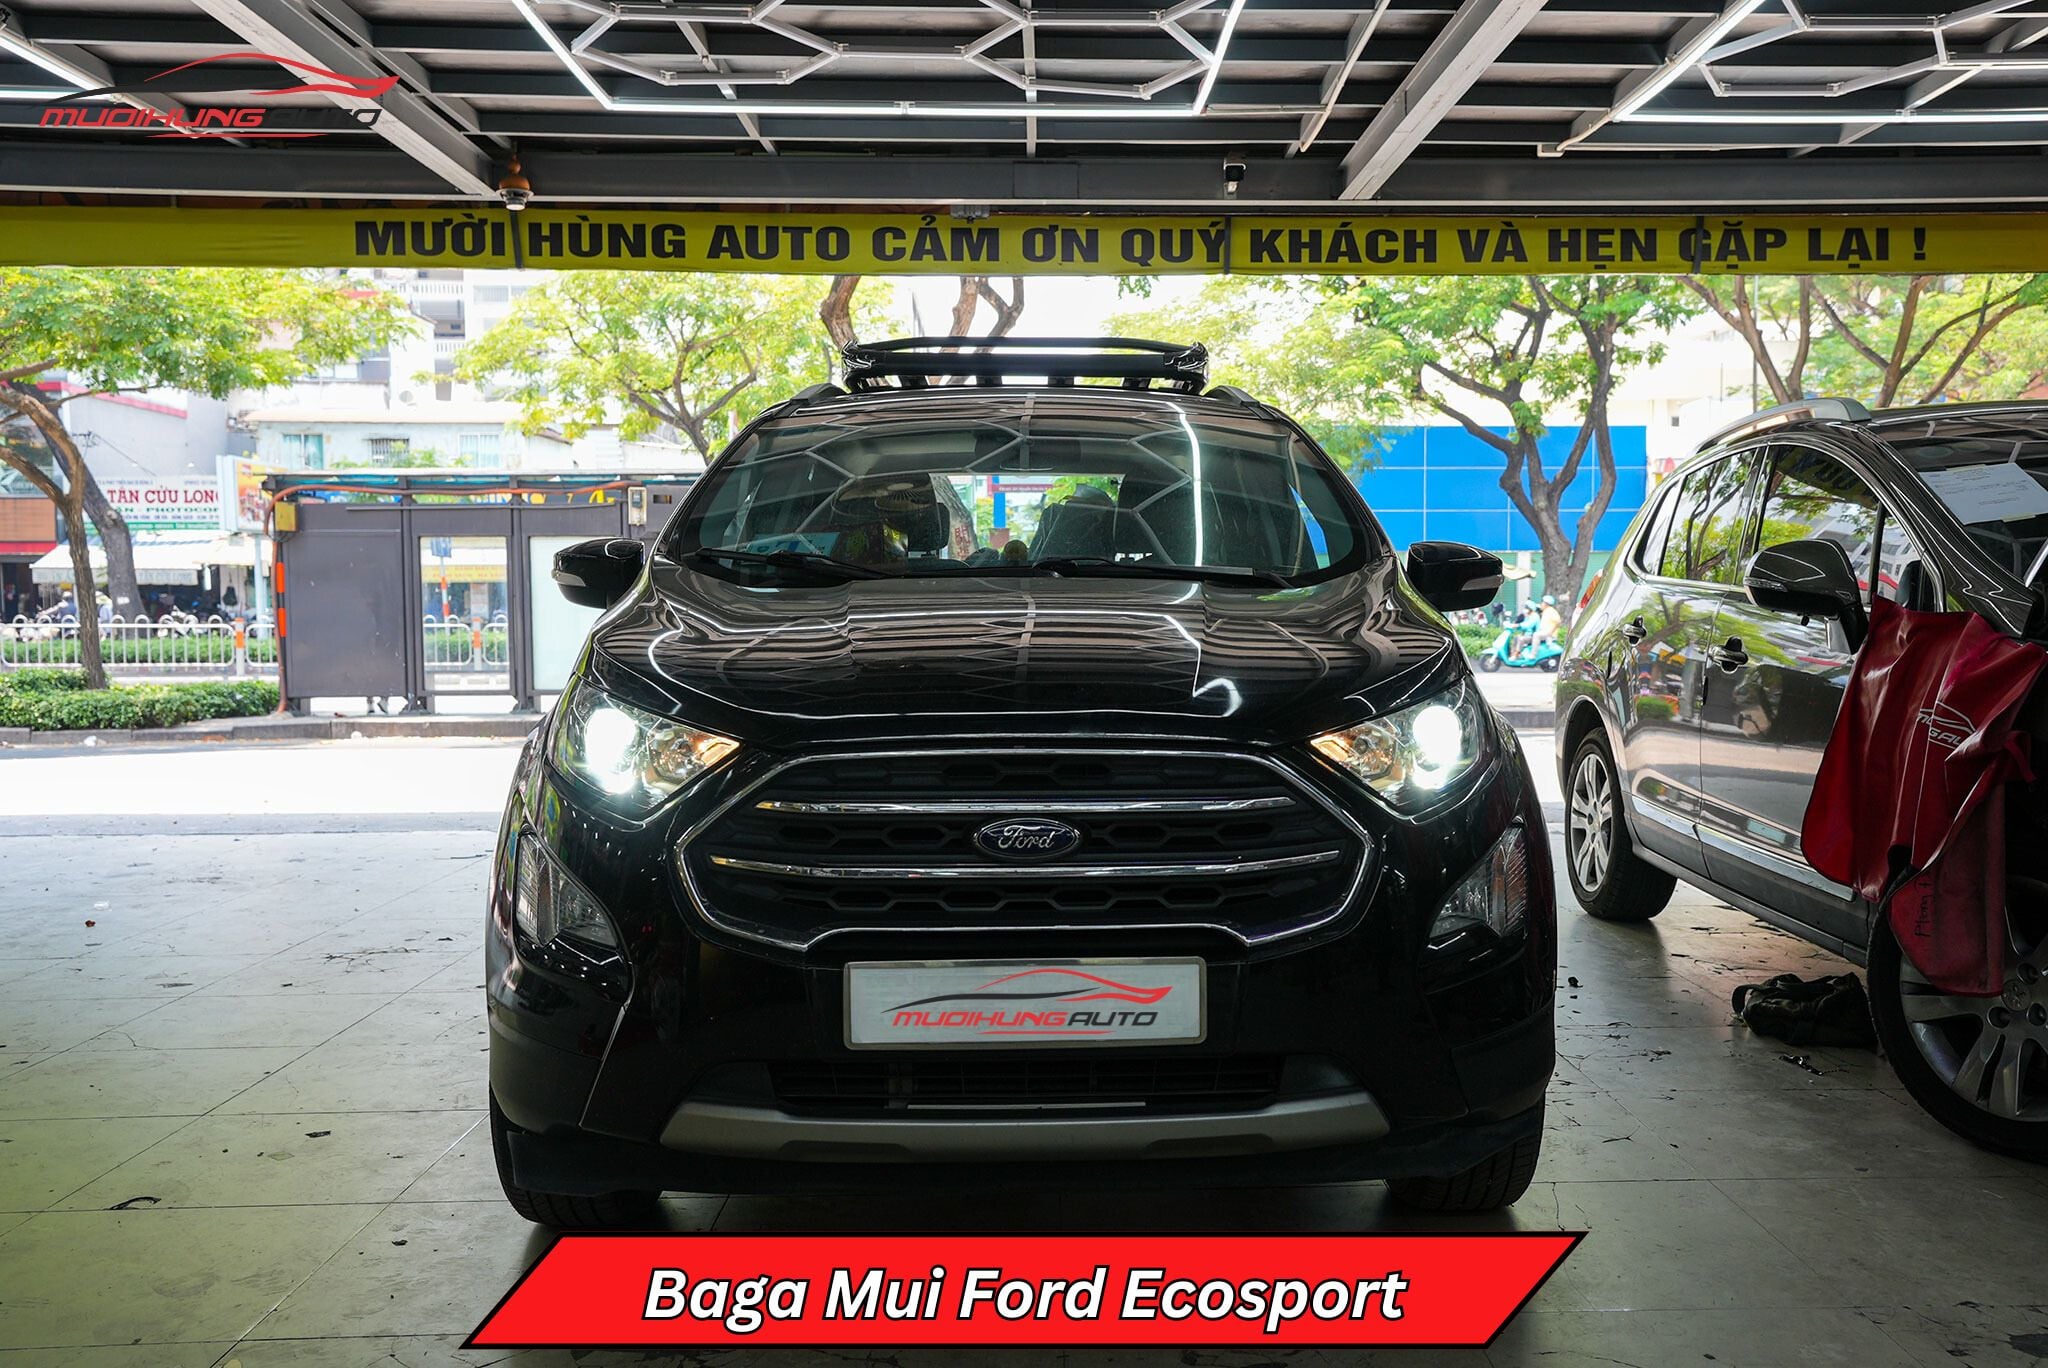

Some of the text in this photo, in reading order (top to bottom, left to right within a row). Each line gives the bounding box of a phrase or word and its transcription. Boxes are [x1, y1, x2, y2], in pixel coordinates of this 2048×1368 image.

[356, 213, 1927, 270] MƯỜI HÙNG AUTO CẢM ƠN QUÝ KHÁCH VÀ HẸN GẶP LẠI !
[184, 489, 219, 504] LON
[998, 824, 1057, 849] Ford
